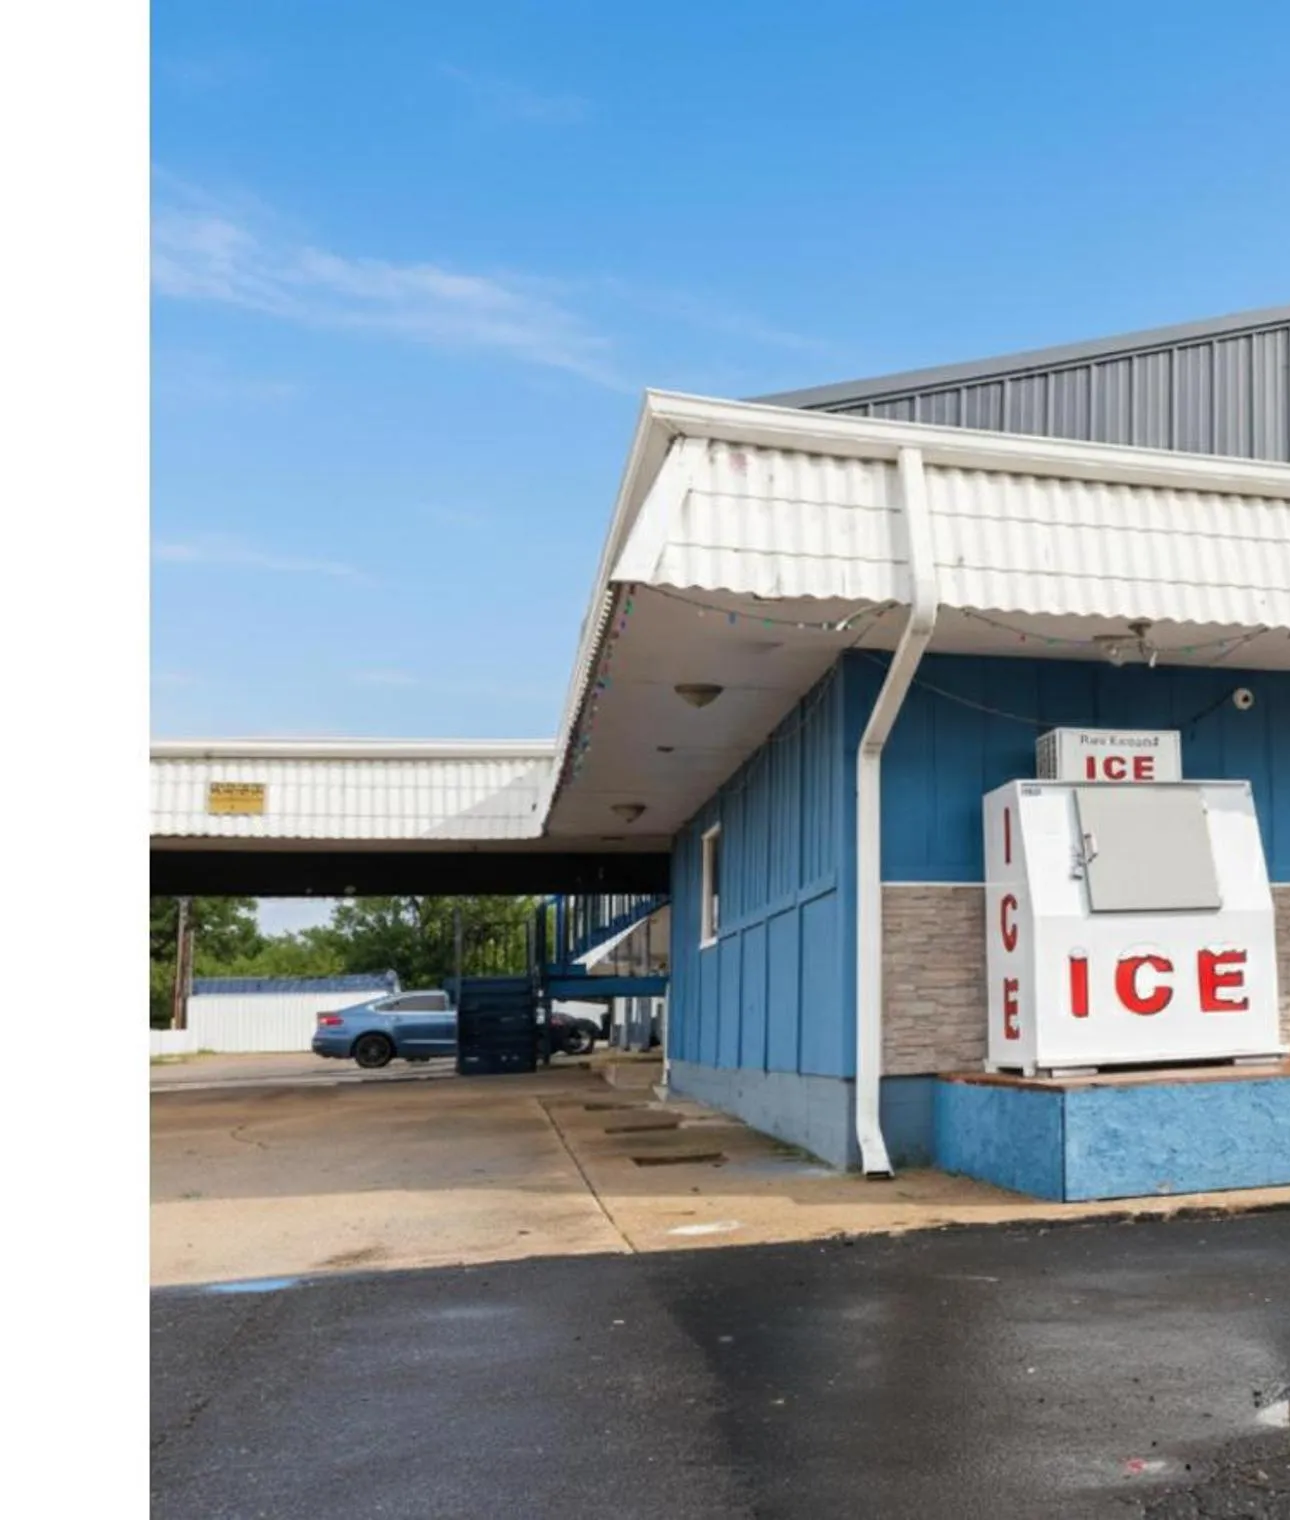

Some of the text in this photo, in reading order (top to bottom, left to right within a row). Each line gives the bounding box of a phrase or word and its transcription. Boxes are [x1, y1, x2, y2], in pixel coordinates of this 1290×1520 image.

[1086, 755, 1154, 780] ICE
[1001, 807, 1020, 1040] ICE
[1068, 949, 1249, 1018] ICE
